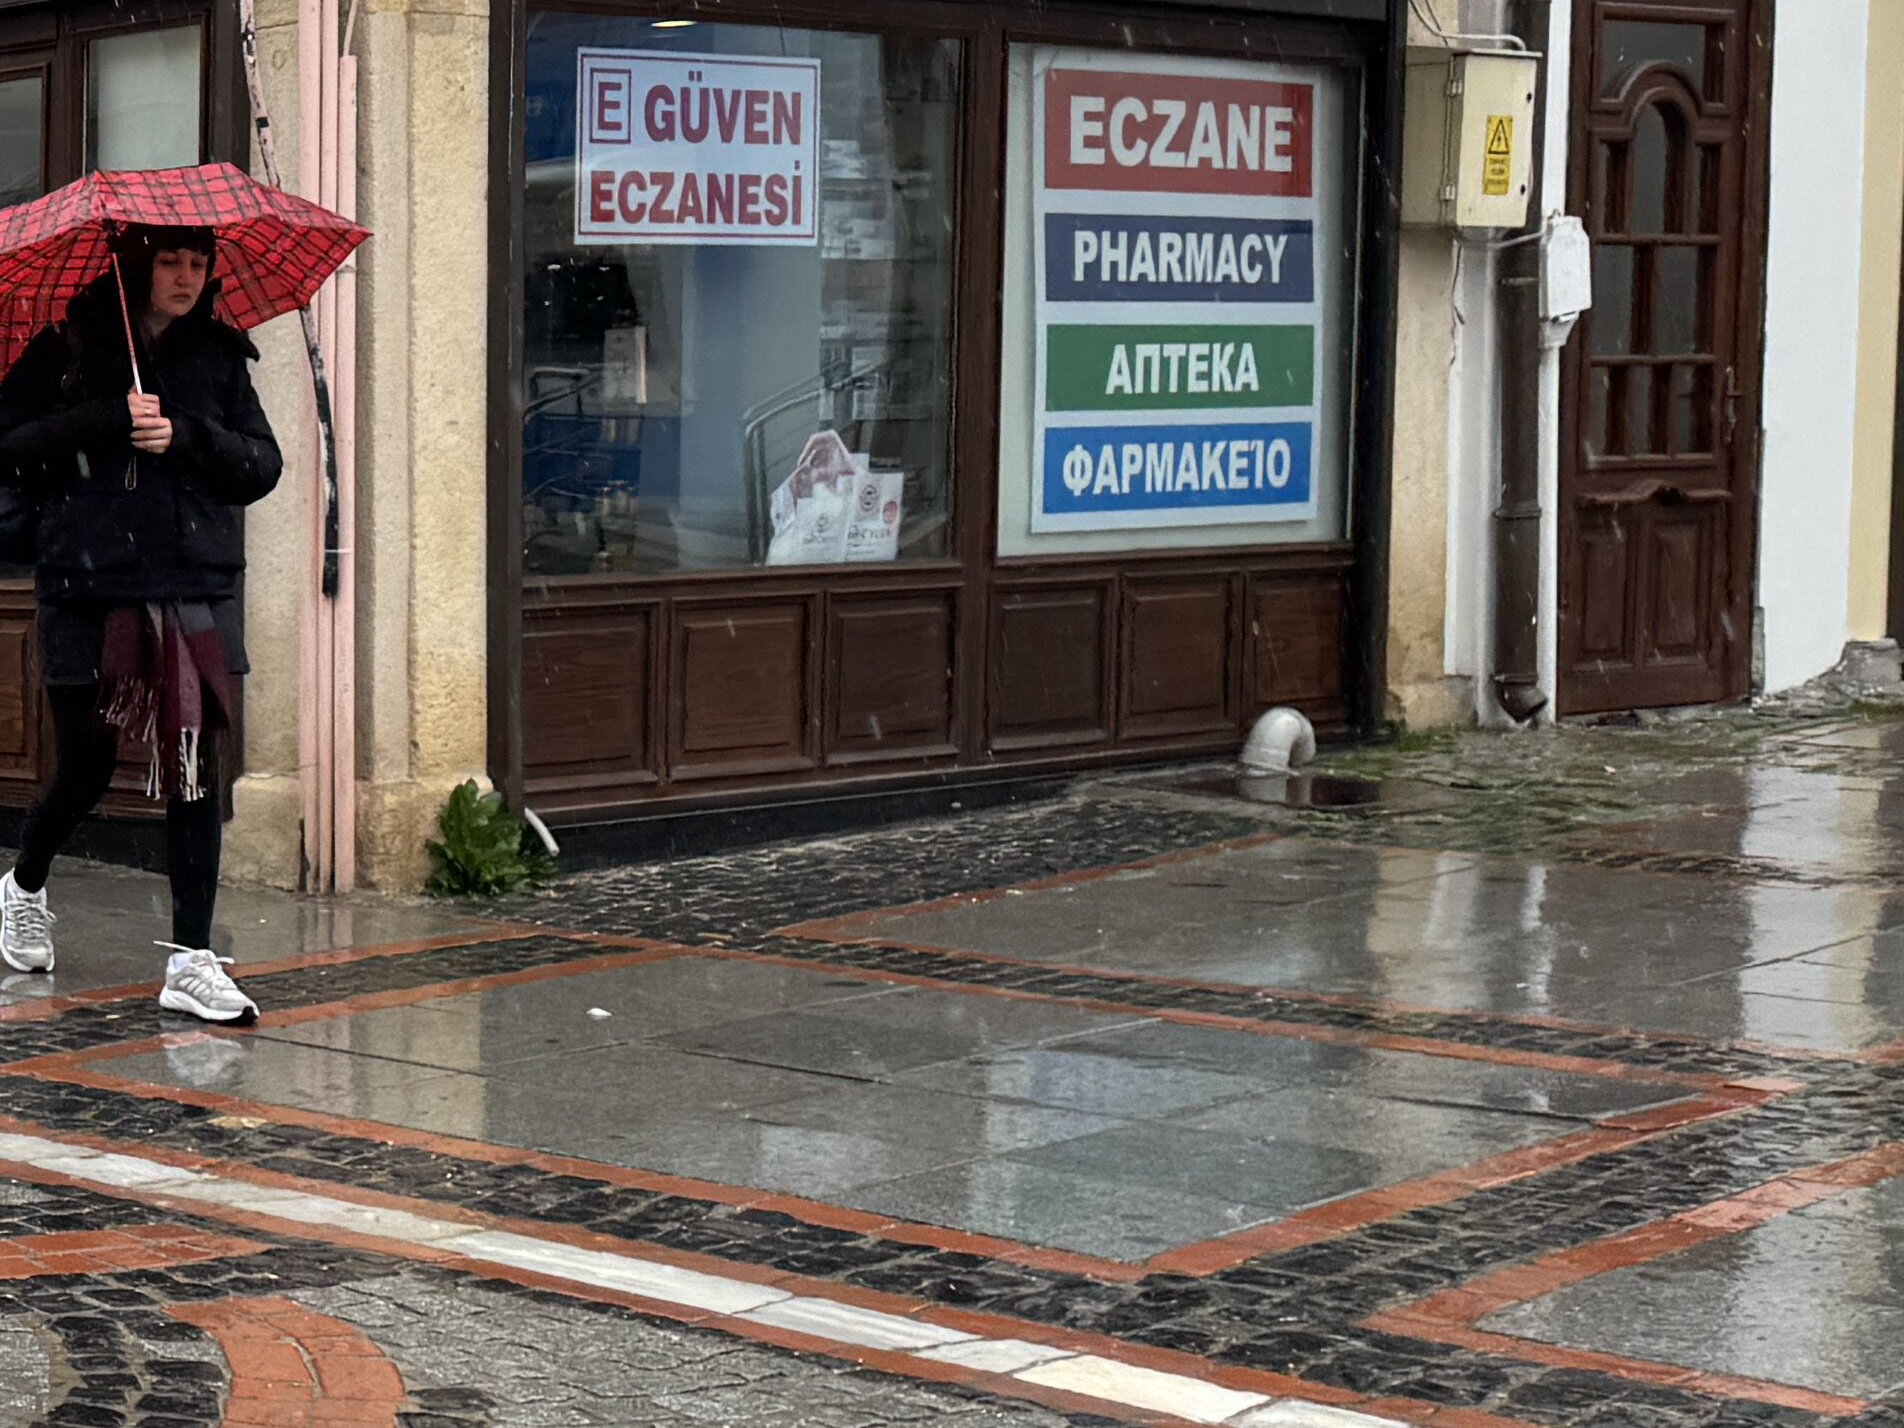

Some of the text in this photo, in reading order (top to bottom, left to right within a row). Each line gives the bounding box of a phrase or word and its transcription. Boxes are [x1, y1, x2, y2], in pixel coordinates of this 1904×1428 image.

[598, 70, 801, 145] E GÜVEN
[1070, 95, 1292, 172] ECZANE
[590, 160, 802, 227] ECZANESİ
[1074, 230, 1288, 284] PHARMACY
[1105, 342, 1260, 395] АПТЕКА
